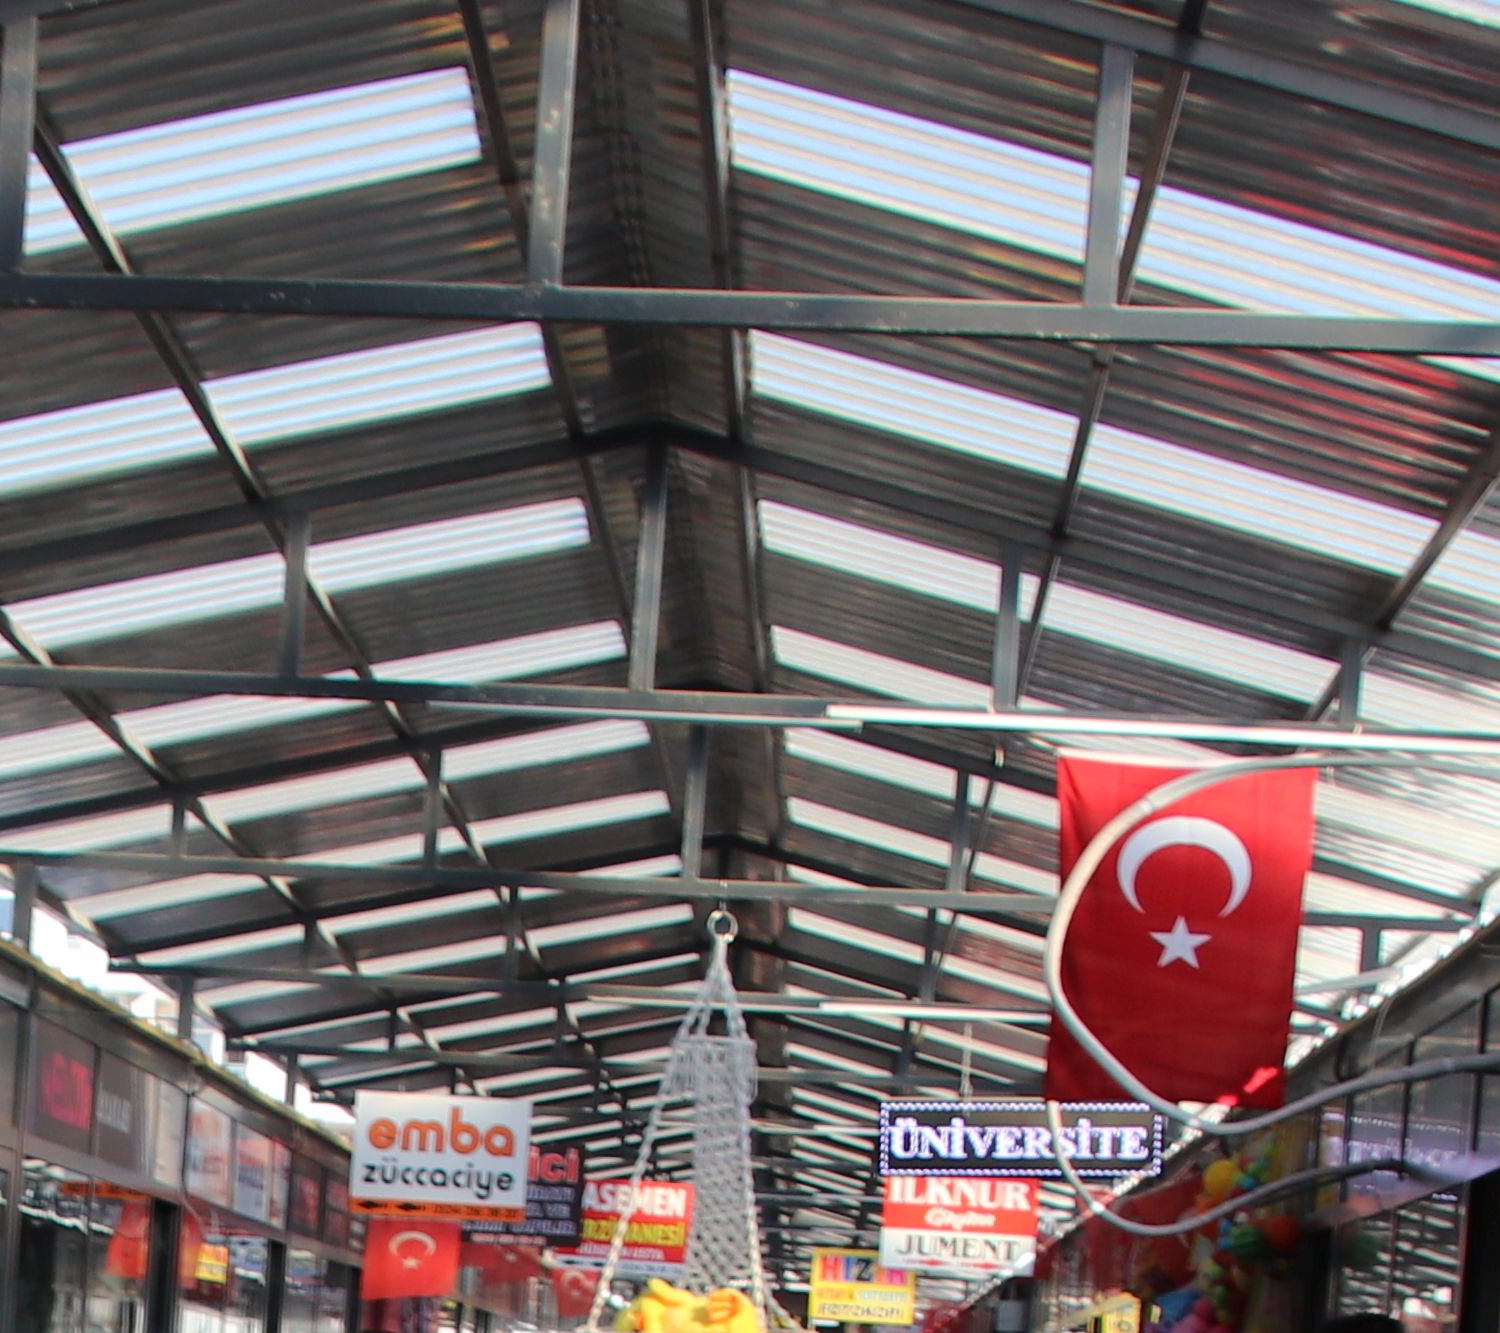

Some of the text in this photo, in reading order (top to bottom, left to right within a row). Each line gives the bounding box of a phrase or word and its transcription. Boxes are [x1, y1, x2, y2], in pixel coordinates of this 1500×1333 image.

[367, 1106, 516, 1157] emba
[888, 1117, 1149, 1160] ÜNİVERSİTE
[363, 1158, 515, 1200] züccaciye
[581, 1182, 688, 1218] ASEMEN
[899, 1234, 1021, 1261] JUMENT
